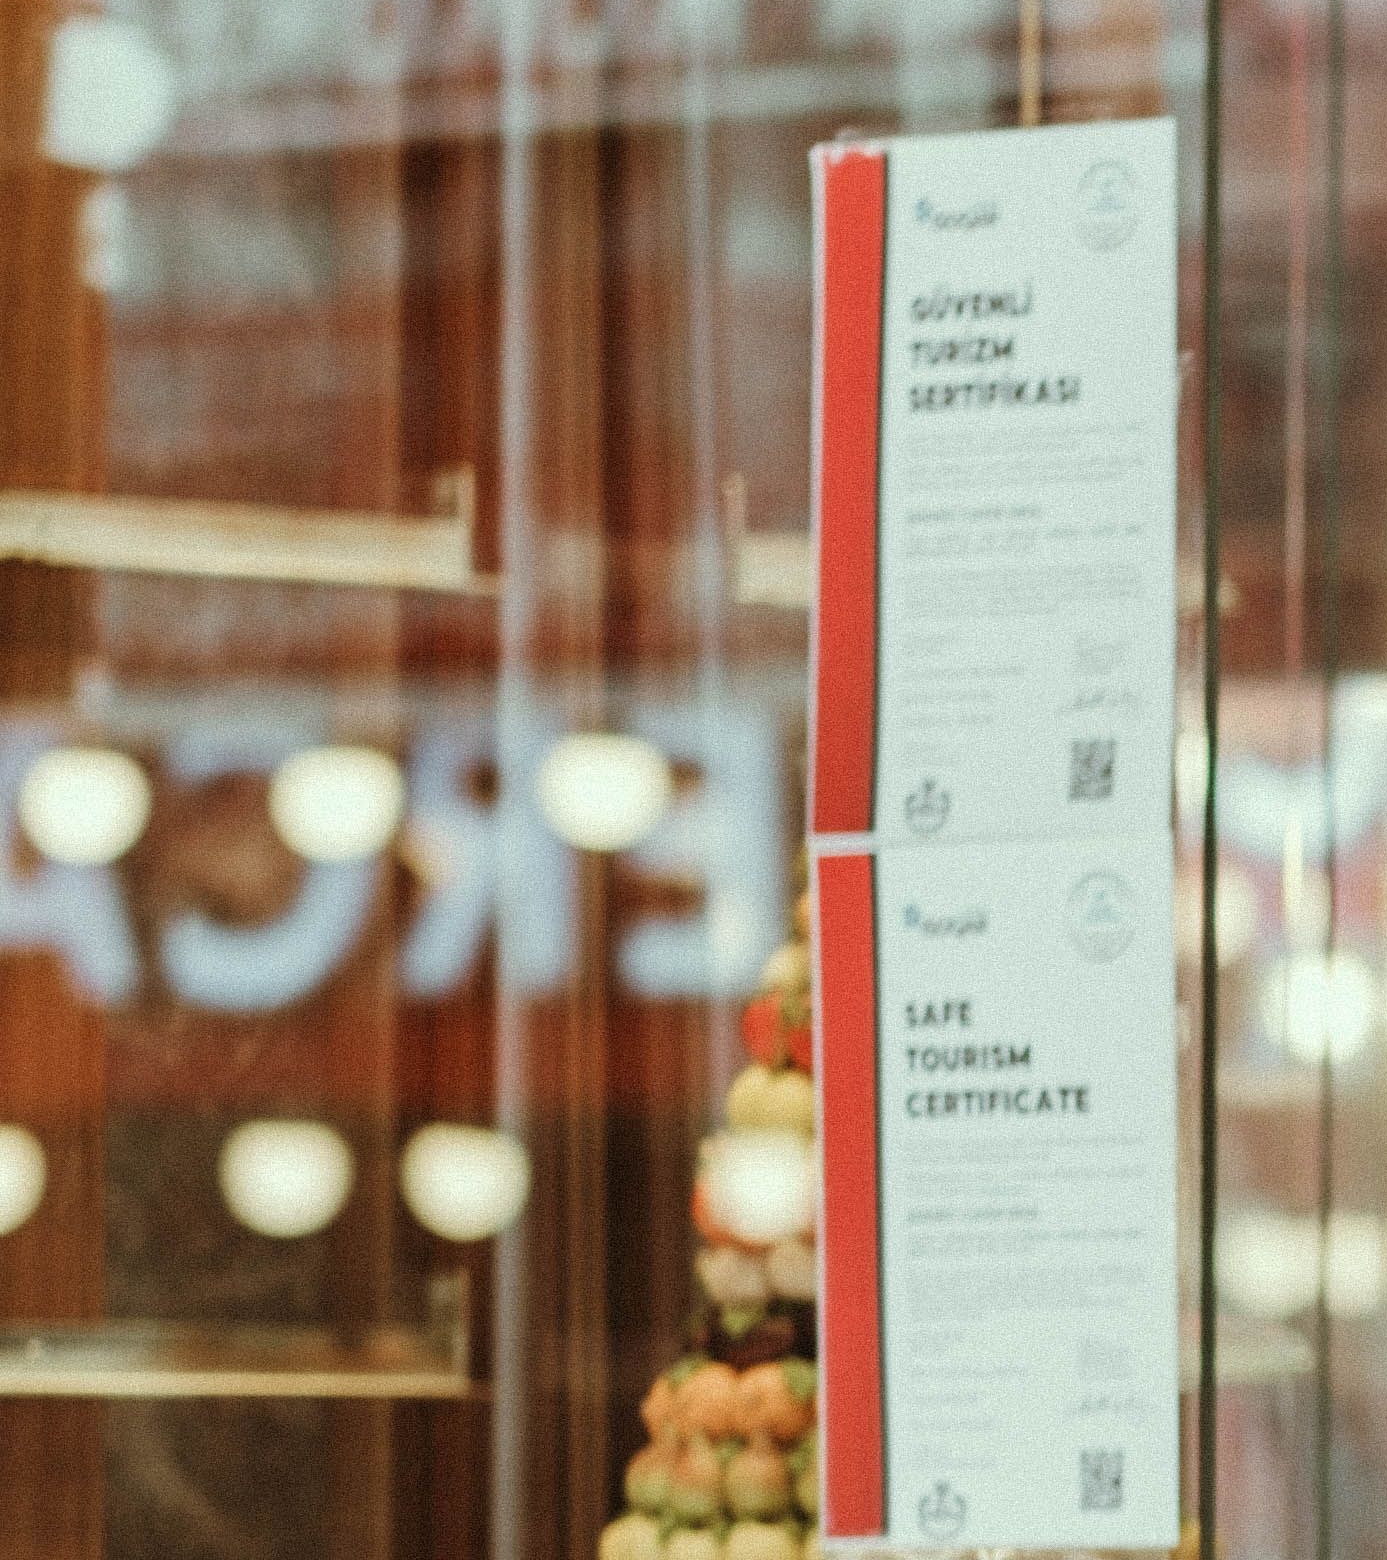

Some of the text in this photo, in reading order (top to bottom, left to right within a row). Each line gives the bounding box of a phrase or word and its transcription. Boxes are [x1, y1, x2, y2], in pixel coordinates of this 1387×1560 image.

[905, 999, 972, 1029] SAFE
[906, 1042, 1032, 1073] TOURISM
[905, 1083, 1091, 1119] CERTIFICATE
